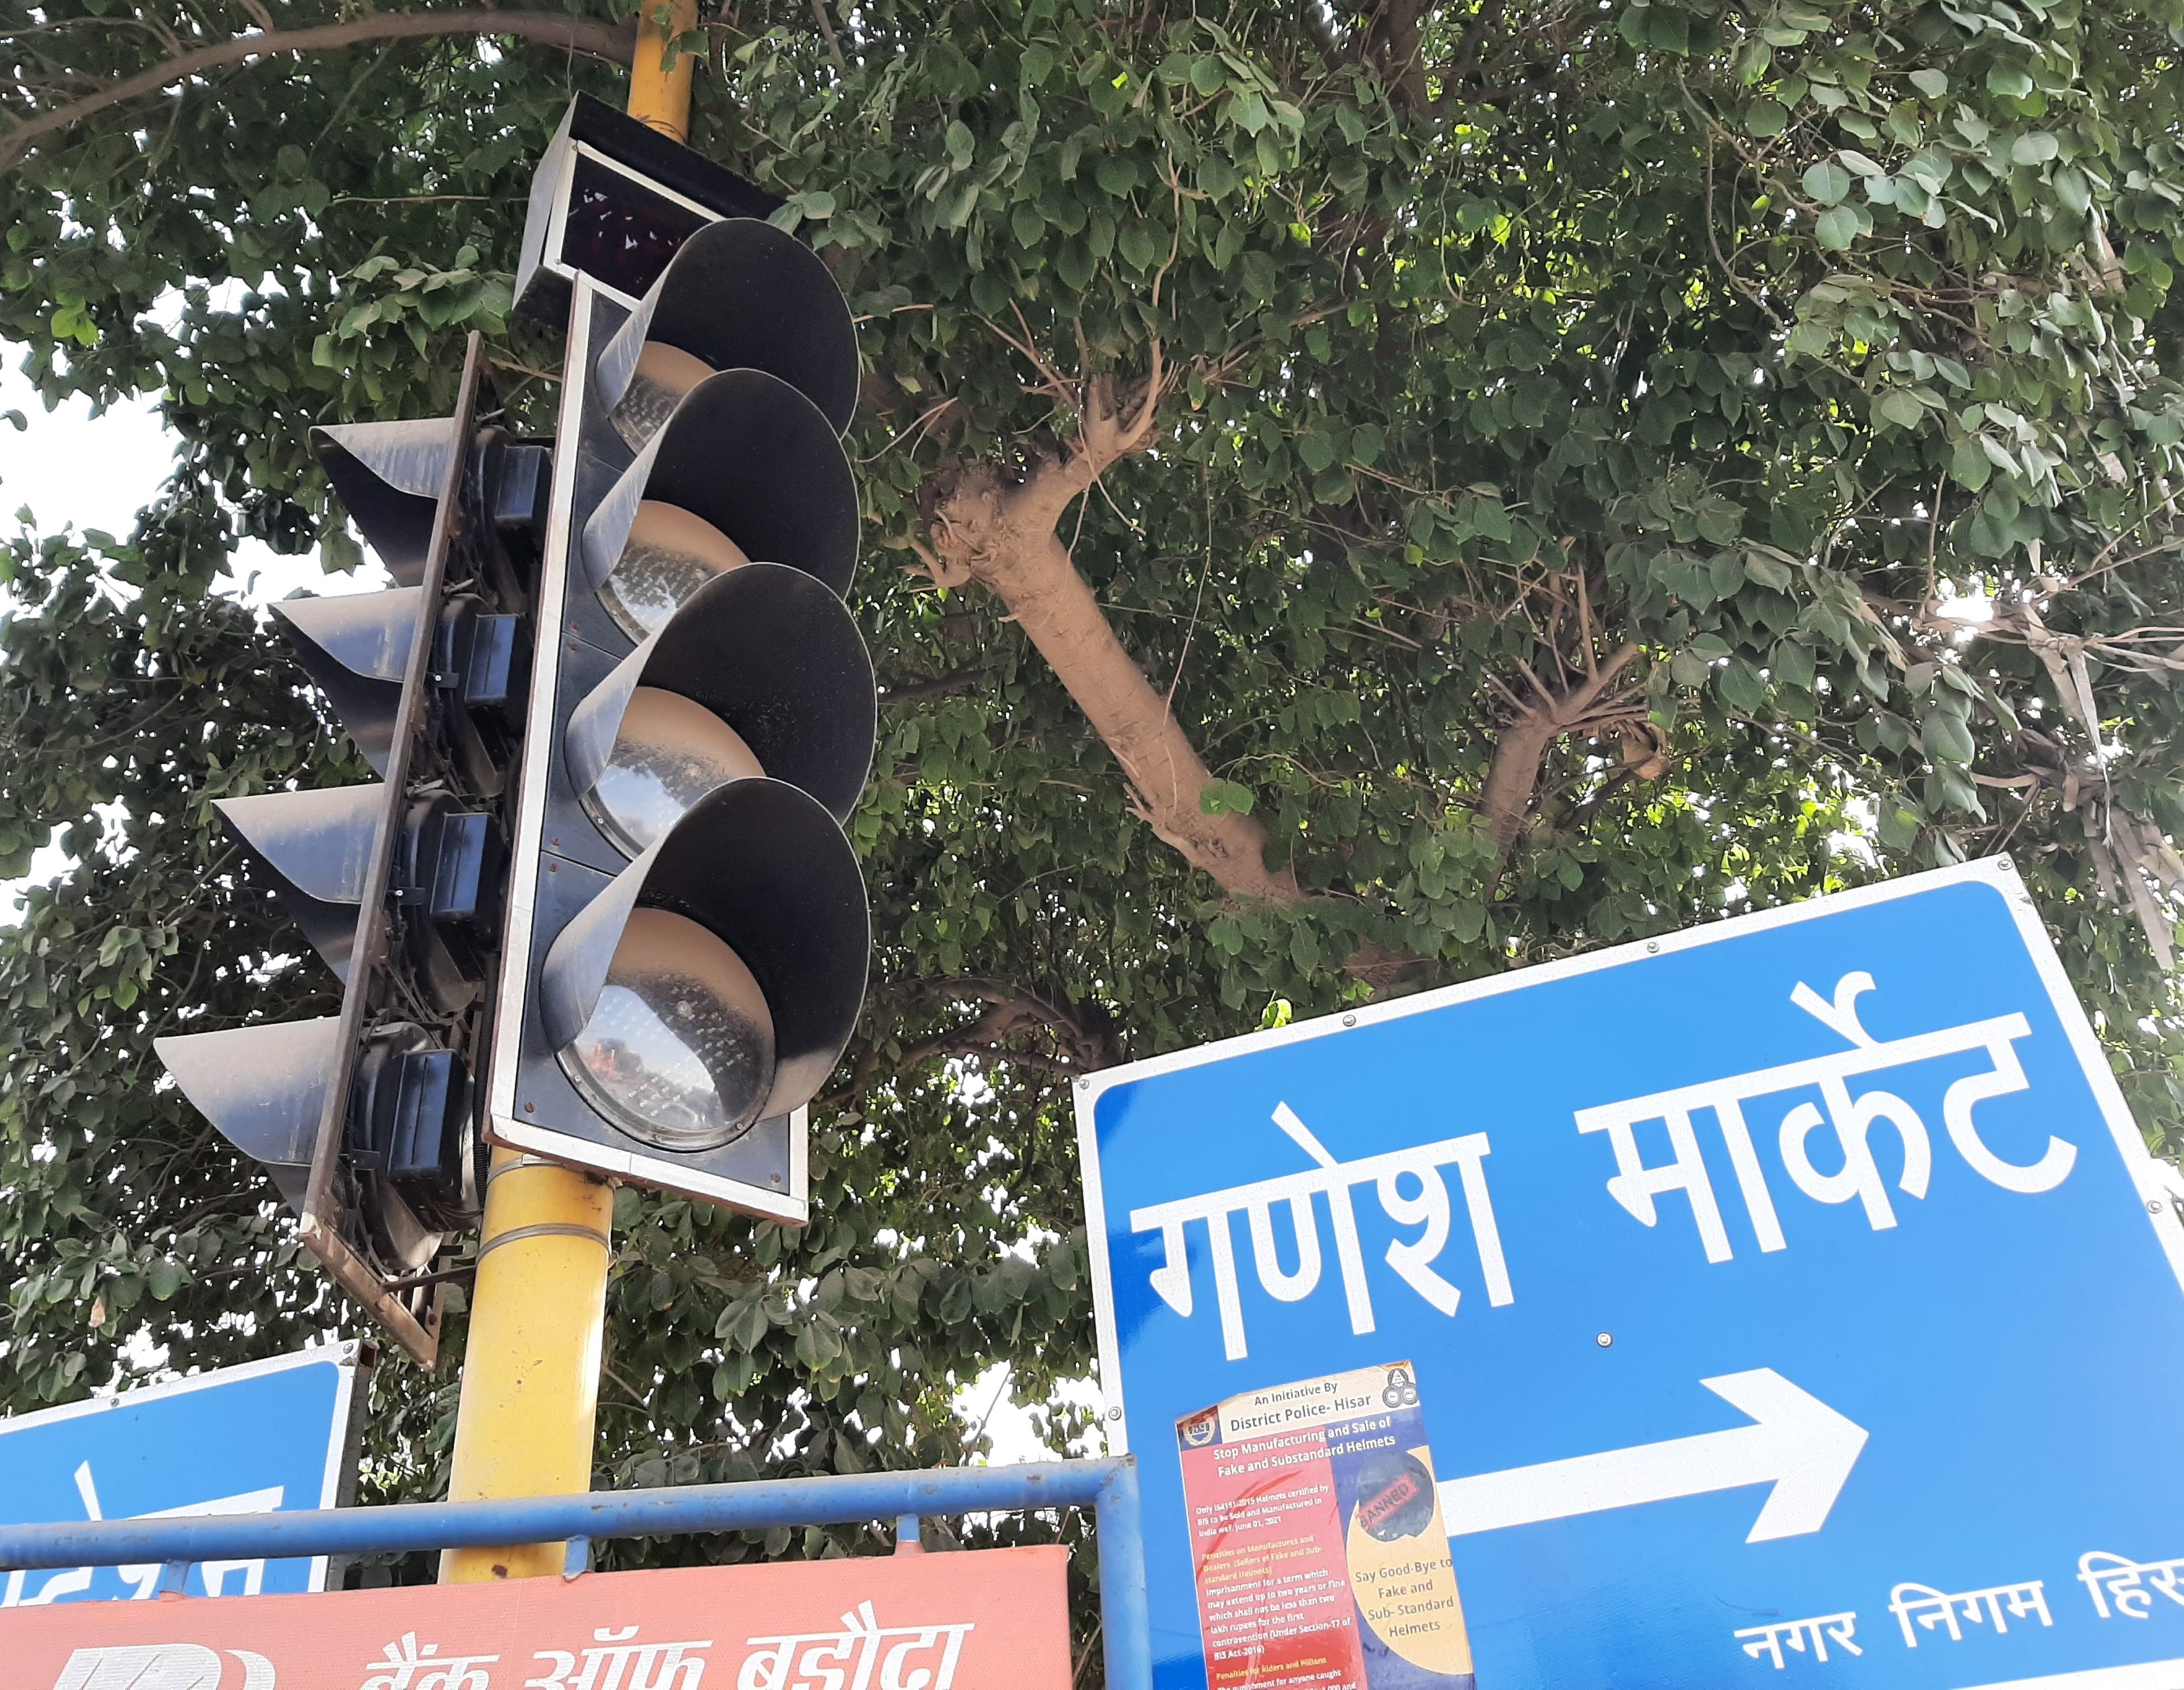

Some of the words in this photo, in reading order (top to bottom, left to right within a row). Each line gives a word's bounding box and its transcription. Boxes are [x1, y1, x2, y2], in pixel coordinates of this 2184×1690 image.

[1130, 1100, 1514, 1361] गणेश
[1573, 969, 2078, 1265] मार्केट
[1255, 1396, 1268, 1406] An
[1272, 1386, 1320, 1402] Initiative
[1324, 1382, 1338, 1394] By
[1231, 1412, 1281, 1431] District
[1286, 1405, 1331, 1420] Police-
[1335, 1395, 1371, 1411] Hisar
[1213, 1447, 1238, 1460] Stop
[1242, 1430, 1326, 1454] Manufacturing
[1328, 1424, 1349, 1438] and
[1352, 1420, 1376, 1434] Sale
[1379, 1416, 1391, 1427] of
[1218, 1464, 1245, 1477] Fake
[1247, 1458, 1268, 1471] and
[1272, 1443, 1344, 1467] Substandard
[1347, 1436, 1396, 1452] Helmets
[1196, 1505, 1213, 1515] Only
[1256, 1493, 1286, 1504] Helmets
[1288, 1485, 1318, 1498] certified
[1319, 1484, 1329, 1493] by
[1229, 1511, 1245, 1520] Sold
[1246, 1508, 1260, 1516] and
[1262, 1499, 1313, 1513] Manufactured
[1360, 1483, 1409, 1530] BANNED
[1198, 1529, 1217, 1537] India
[1202, 1549, 1235, 1560] Penalties
[1300, 1534, 1313, 1544] and
[1203, 1562, 1230, 1572] Dealers
[1271, 1551, 1289, 1560] Fake
[1290, 1548, 1304, 1556] and
[1206, 1581, 1261, 1597] Imprisonment
[1263, 1578, 1273, 1586] for
[1283, 1573, 1302, 1583] term
[1304, 1569, 1328, 1579] which
[1356, 1571, 1376, 1584] Say
[1441, 1558, 1452, 1568] to
[1207, 1601, 1224, 1609] may
[1226, 1593, 1253, 1606] extend
[1255, 1593, 1265, 1602] up
[1278, 1589, 1293, 1597] two
[1294, 1584, 1316, 1596] years
[1378, 1585, 1407, 1599] Fake
[1411, 1579, 1433, 1593] and
[1209, 1611, 1232, 1621] which
[1234, 1607, 1253, 1617] shall
[1254, 1606, 1268, 1614] not
[1270, 1603, 1280, 1611] be
[1282, 1601, 1298, 1610] less
[1298, 1597, 1317, 1607] than
[1319, 1595, 1335, 1603] two
[1368, 1606, 1395, 1620] Sub-
[1397, 1596, 1454, 1616] Standard
[1210, 1625, 1228, 1634] lakh
[1230, 1622, 1257, 1633] rupees
[1258, 1617, 1270, 1626] for
[1272, 1615, 1285, 1624] the
[1287, 1612, 1304, 1622] first
[1213, 1632, 1268, 1647] contravention
[1342, 1616, 1351, 1626] of
[1389, 1620, 1441, 1637] Helmets
[1734, 1611, 1863, 1670] नगर
[1888, 1582, 2054, 1648] निगम
[1216, 1670, 1249, 1680] Penalties
[1250, 1666, 1259, 1674] for
[1261, 1663, 1284, 1673] Riders
[1286, 1660, 1299, 1669] and
[1289, 1674, 1315, 1684] anyone
[1316, 1669, 1341, 1680] caught
